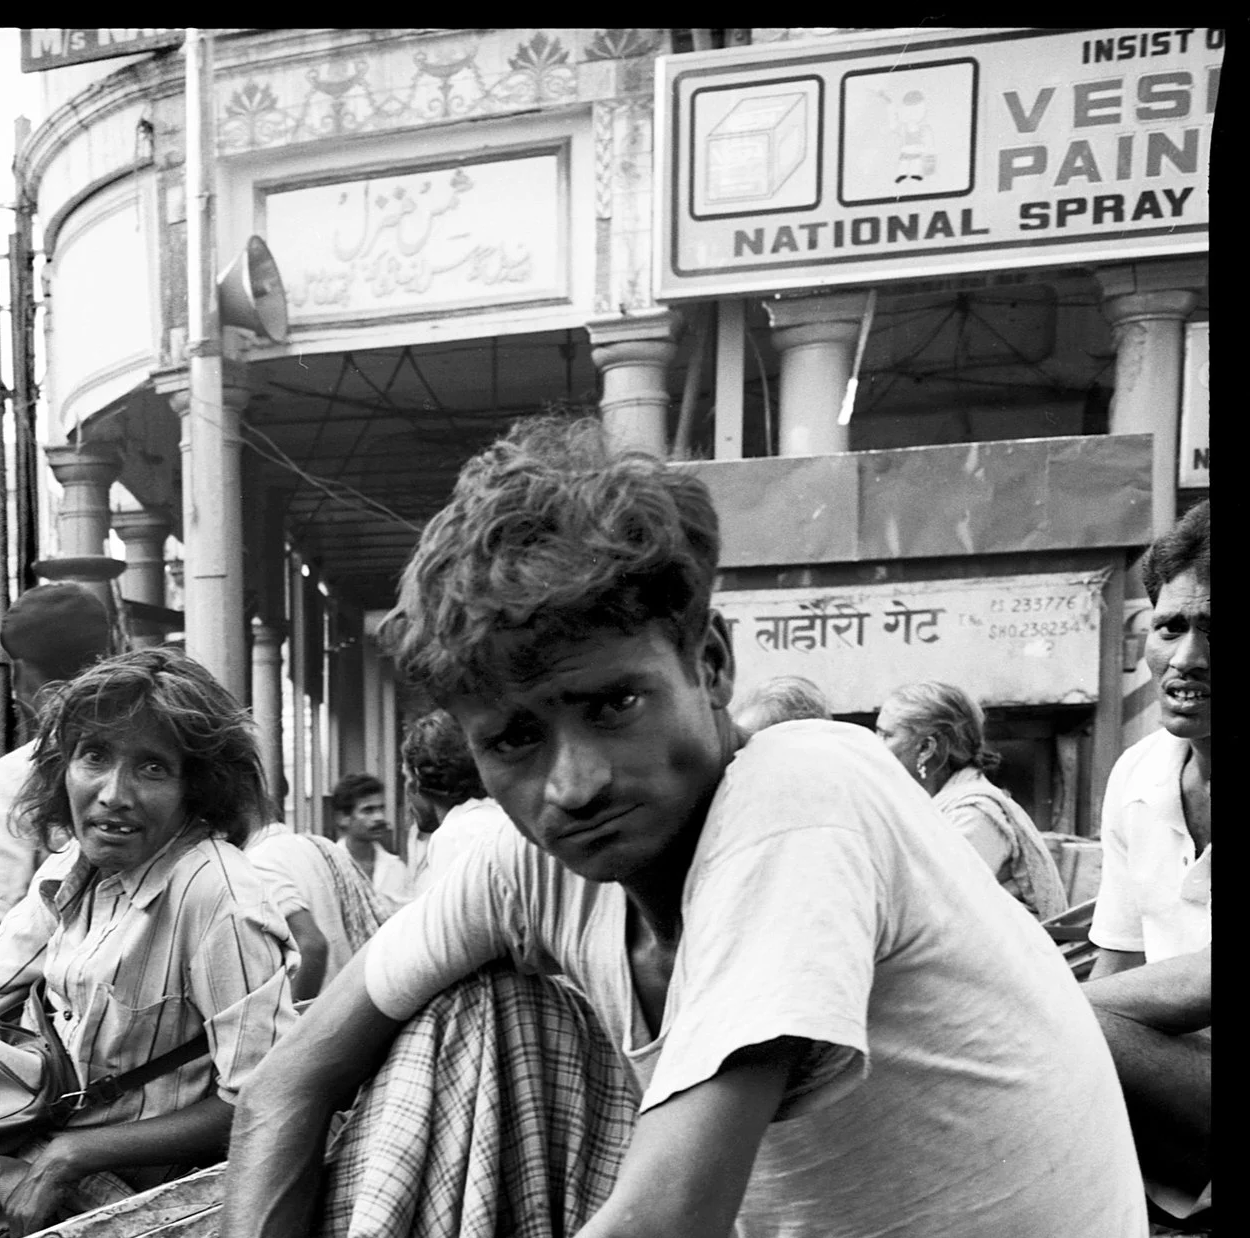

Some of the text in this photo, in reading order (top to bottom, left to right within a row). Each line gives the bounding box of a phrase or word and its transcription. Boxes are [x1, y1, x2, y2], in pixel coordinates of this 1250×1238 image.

[1082, 29, 1194, 64] INSIST
[998, 128, 1200, 193] PAIN
[733, 187, 1195, 258] NATIONAL SPRAY
[884, 600, 946, 645] गेट
